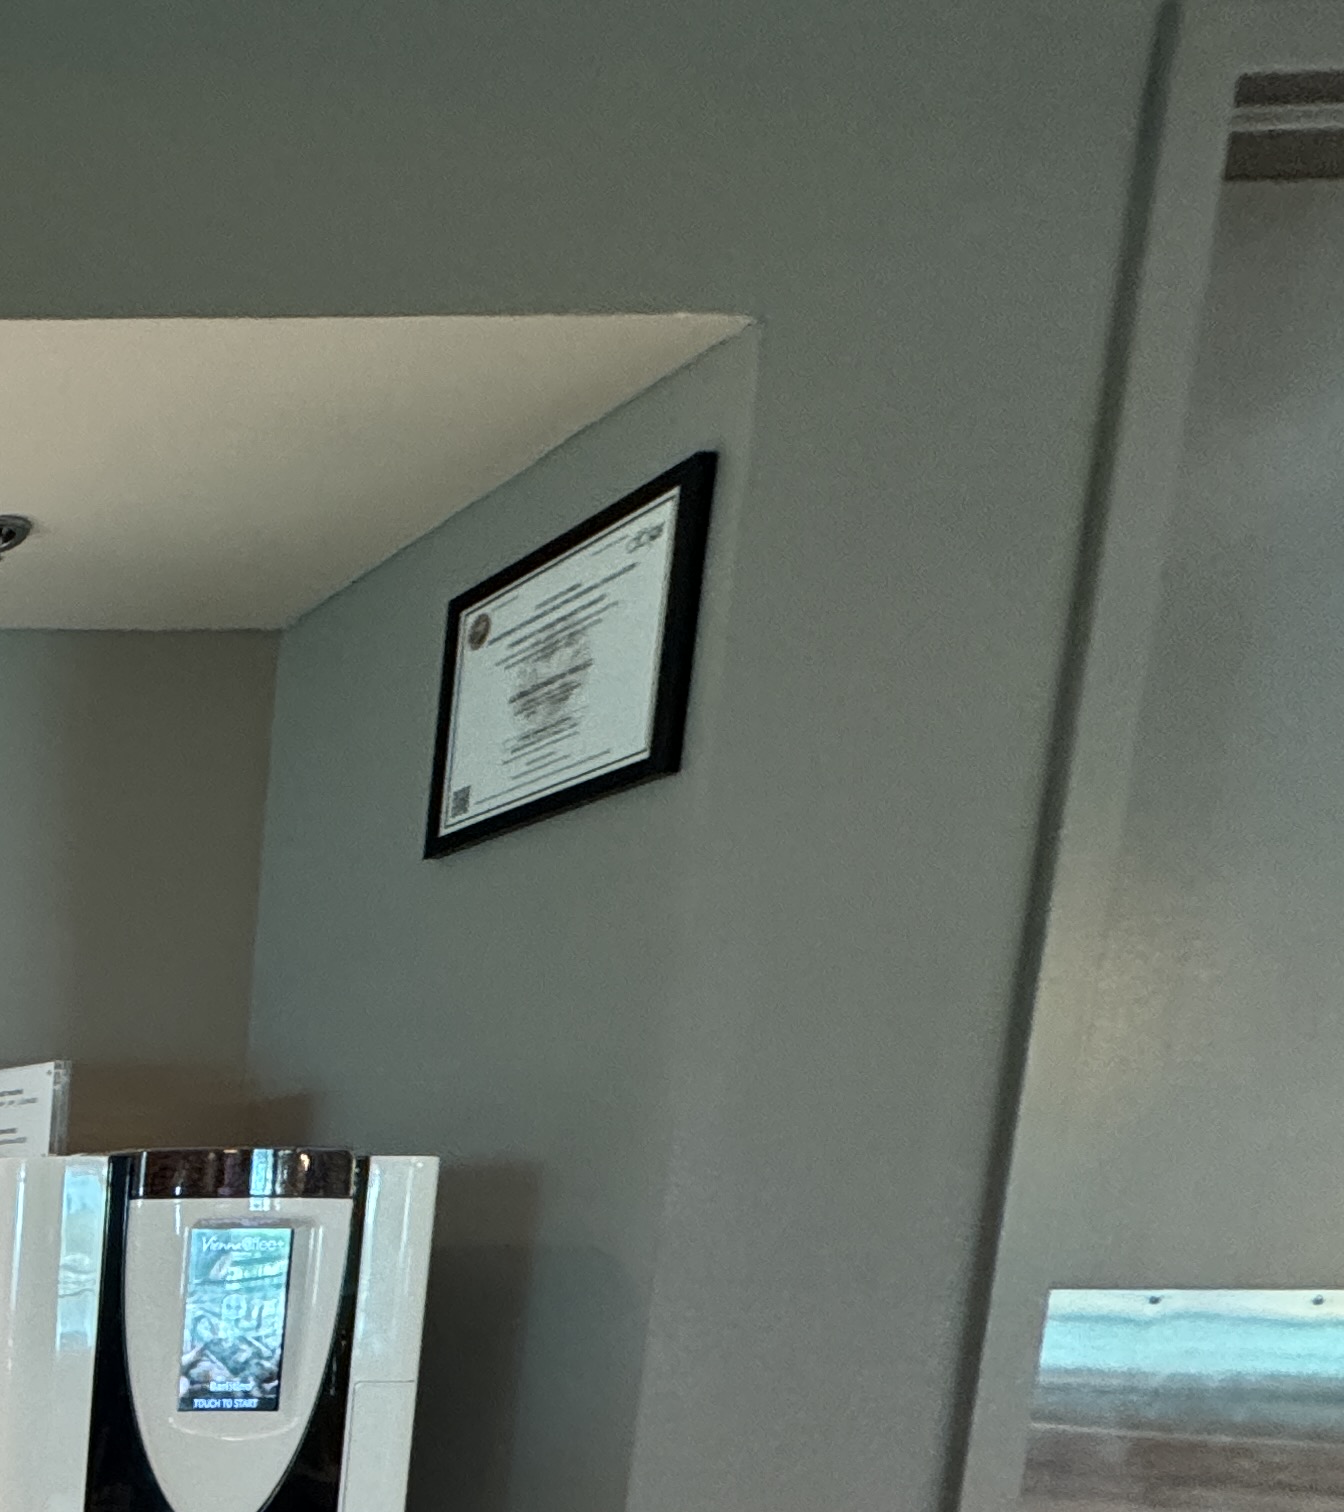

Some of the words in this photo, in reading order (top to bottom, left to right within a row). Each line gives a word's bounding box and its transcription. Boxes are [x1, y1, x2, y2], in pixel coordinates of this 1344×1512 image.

[193, 1398, 221, 1409] TOUCH
[221, 1398, 233, 1409] TO
[234, 1398, 259, 1408] START
